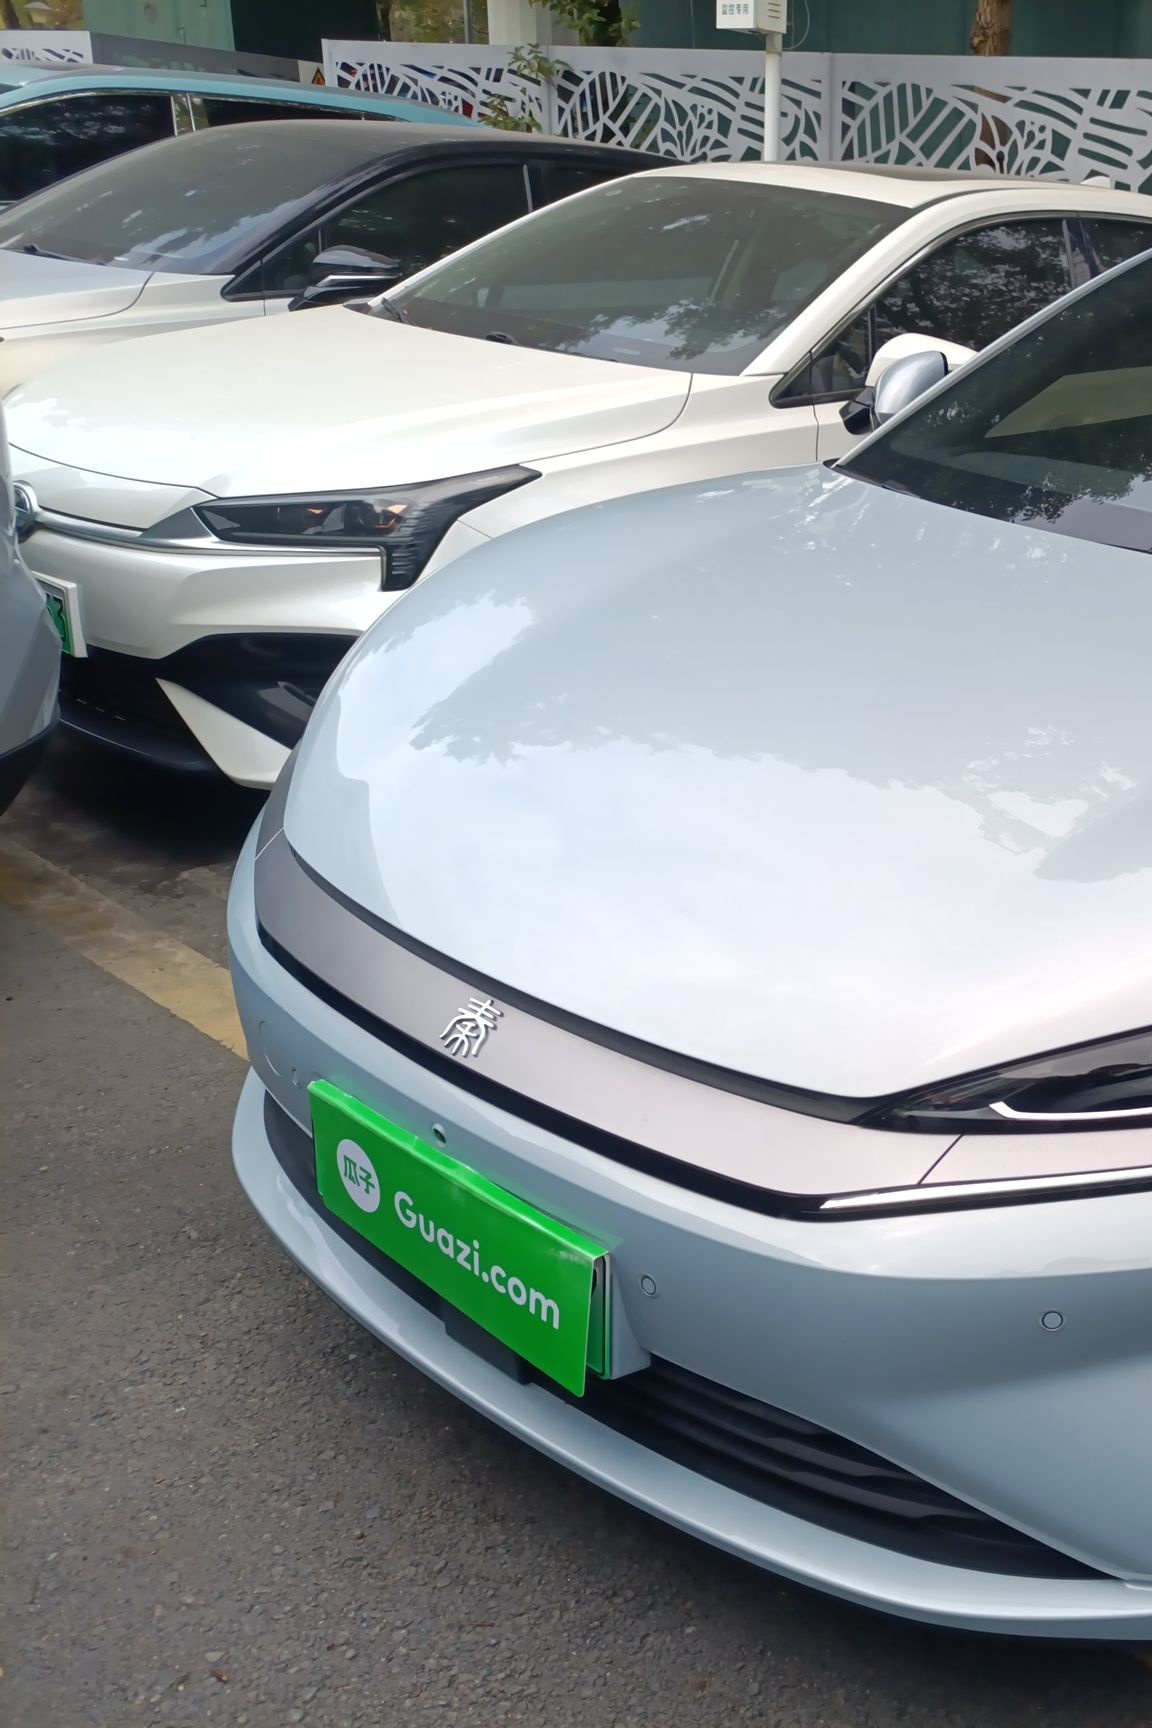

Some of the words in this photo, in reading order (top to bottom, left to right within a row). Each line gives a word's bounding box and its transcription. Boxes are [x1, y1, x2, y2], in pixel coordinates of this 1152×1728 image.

[440, 997, 504, 1058] 秦
[343, 1154, 376, 1195] 瓜子
[393, 1190, 561, 1330] Guazi.com
